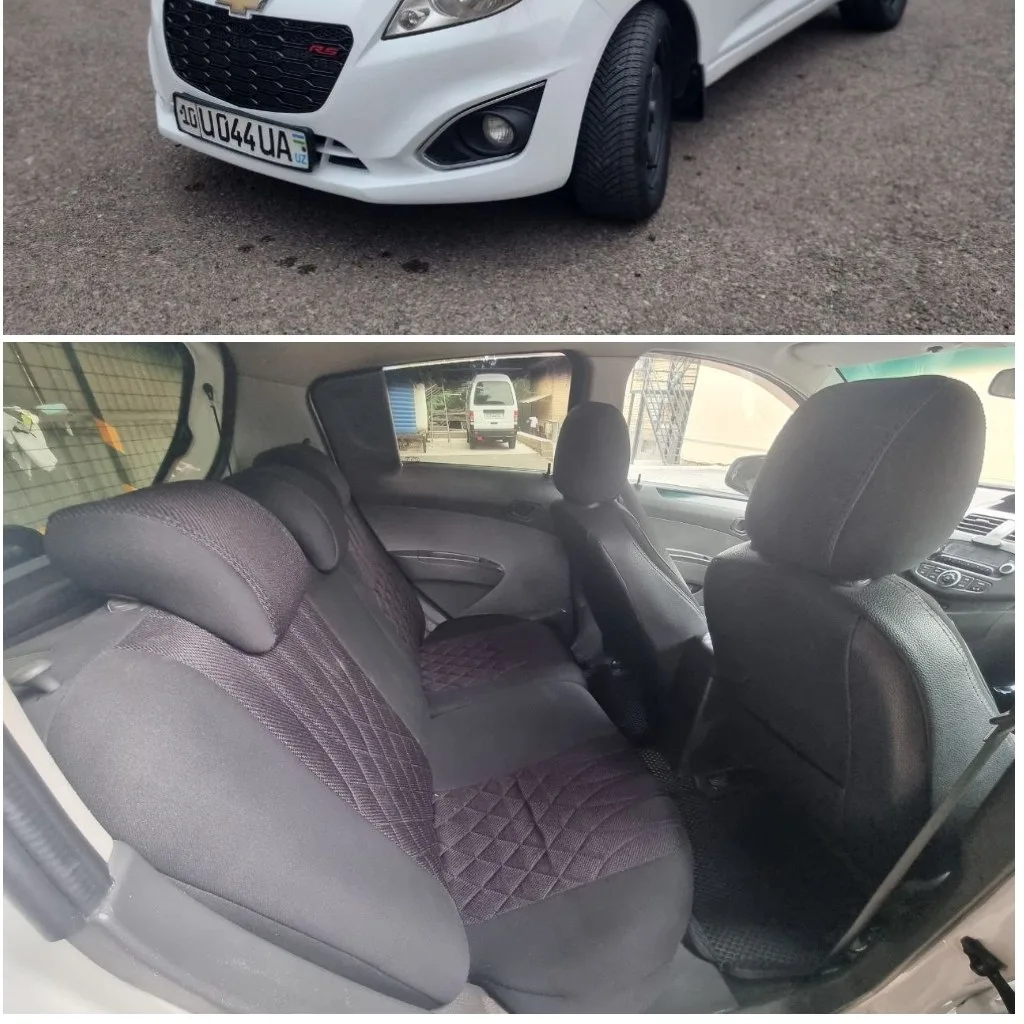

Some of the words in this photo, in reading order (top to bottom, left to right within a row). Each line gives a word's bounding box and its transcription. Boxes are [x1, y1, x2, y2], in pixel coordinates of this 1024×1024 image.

[308, 44, 340, 57] RS
[181, 105, 197, 128] 10
[294, 154, 307, 165] UZ
